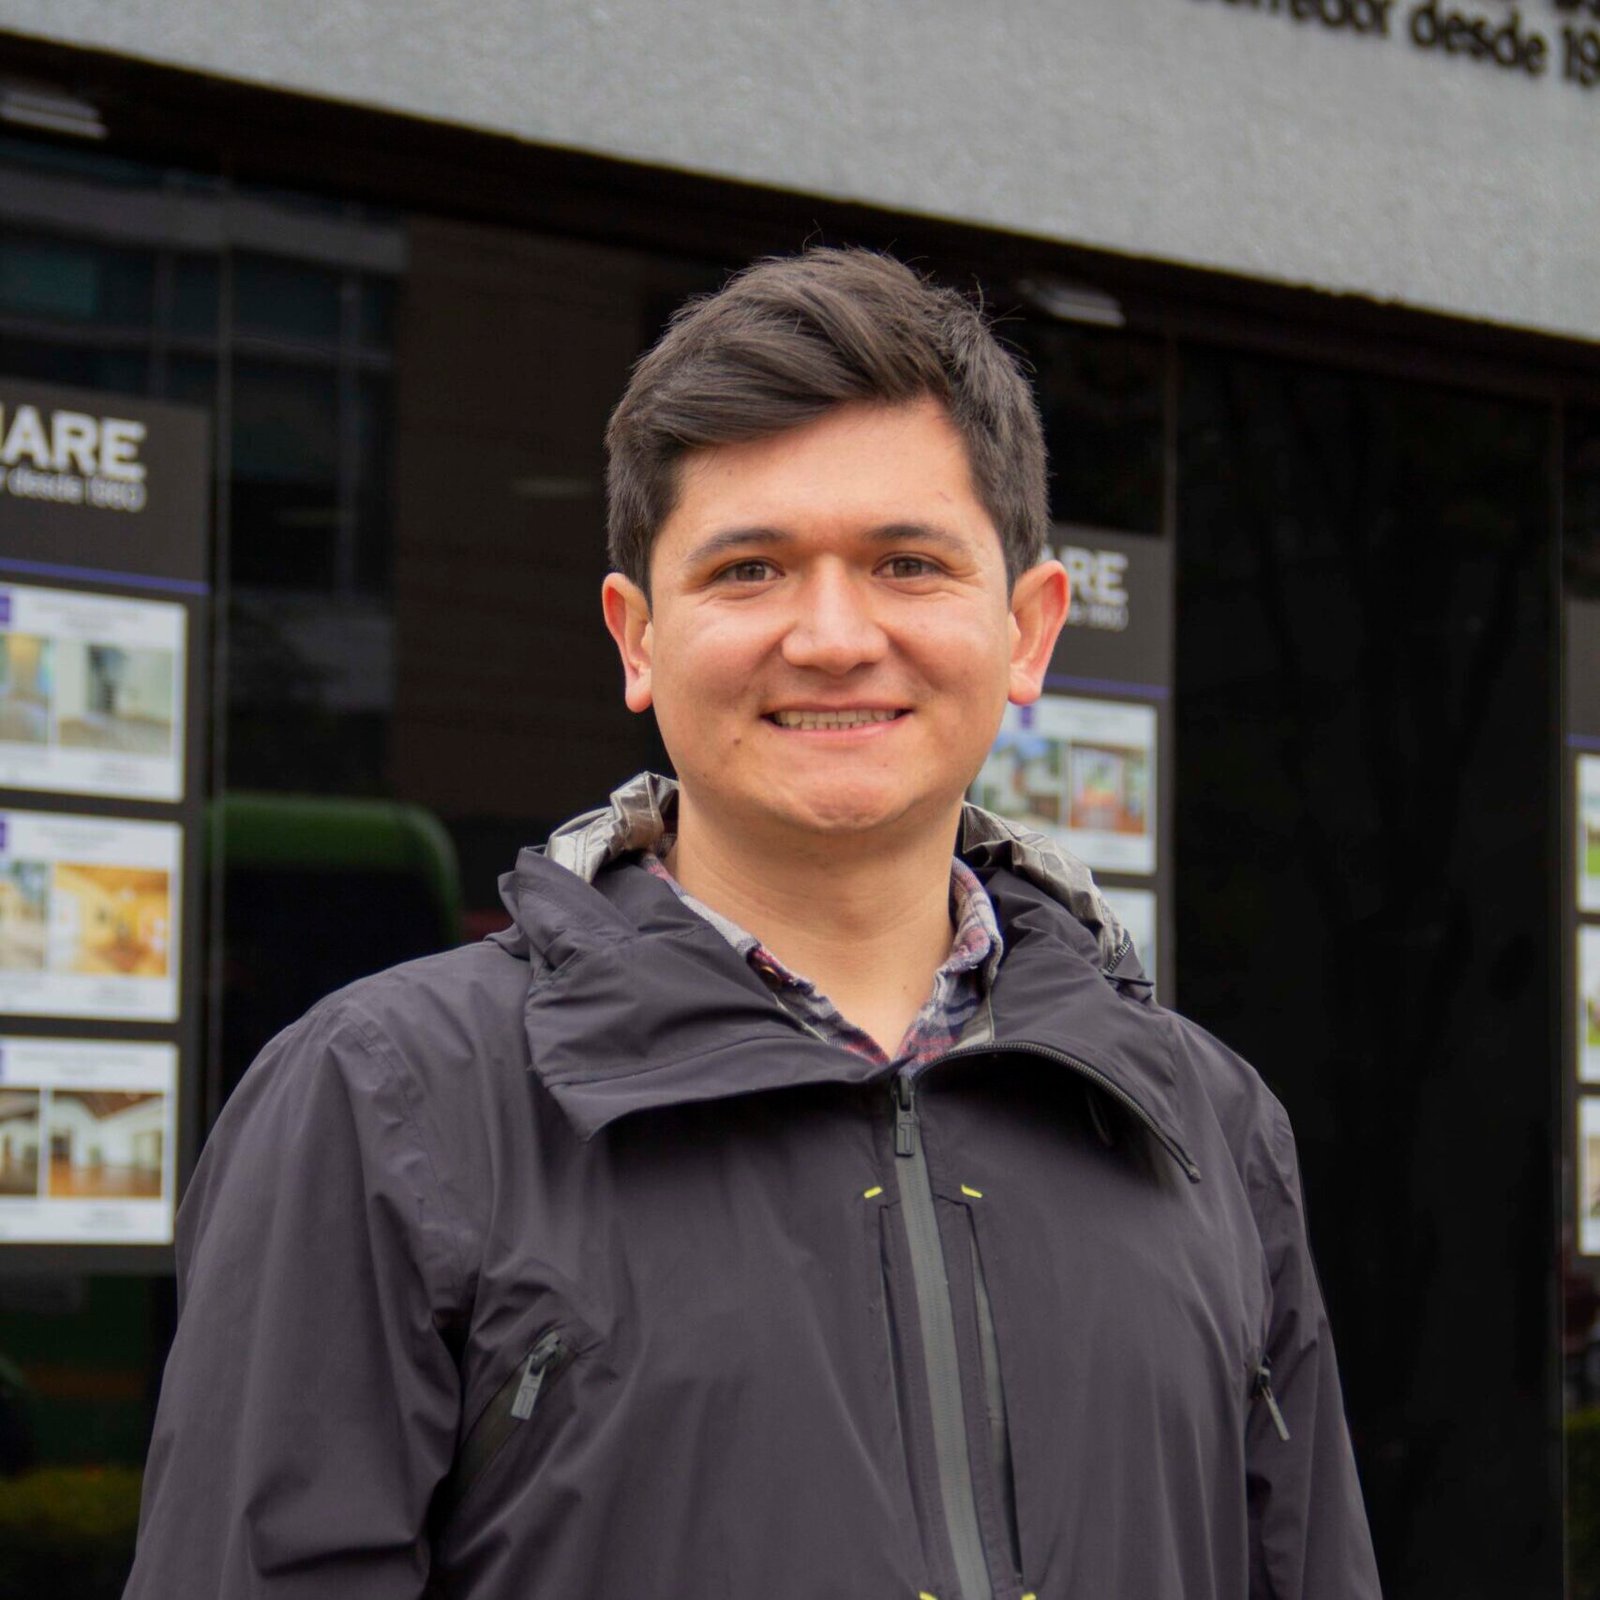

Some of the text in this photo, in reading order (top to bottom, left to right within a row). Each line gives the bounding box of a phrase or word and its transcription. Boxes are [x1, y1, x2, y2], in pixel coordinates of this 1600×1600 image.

[1410, 0, 1548, 76] desde
[0, 402, 146, 479] ARE
[1040, 545, 1129, 606] RE
